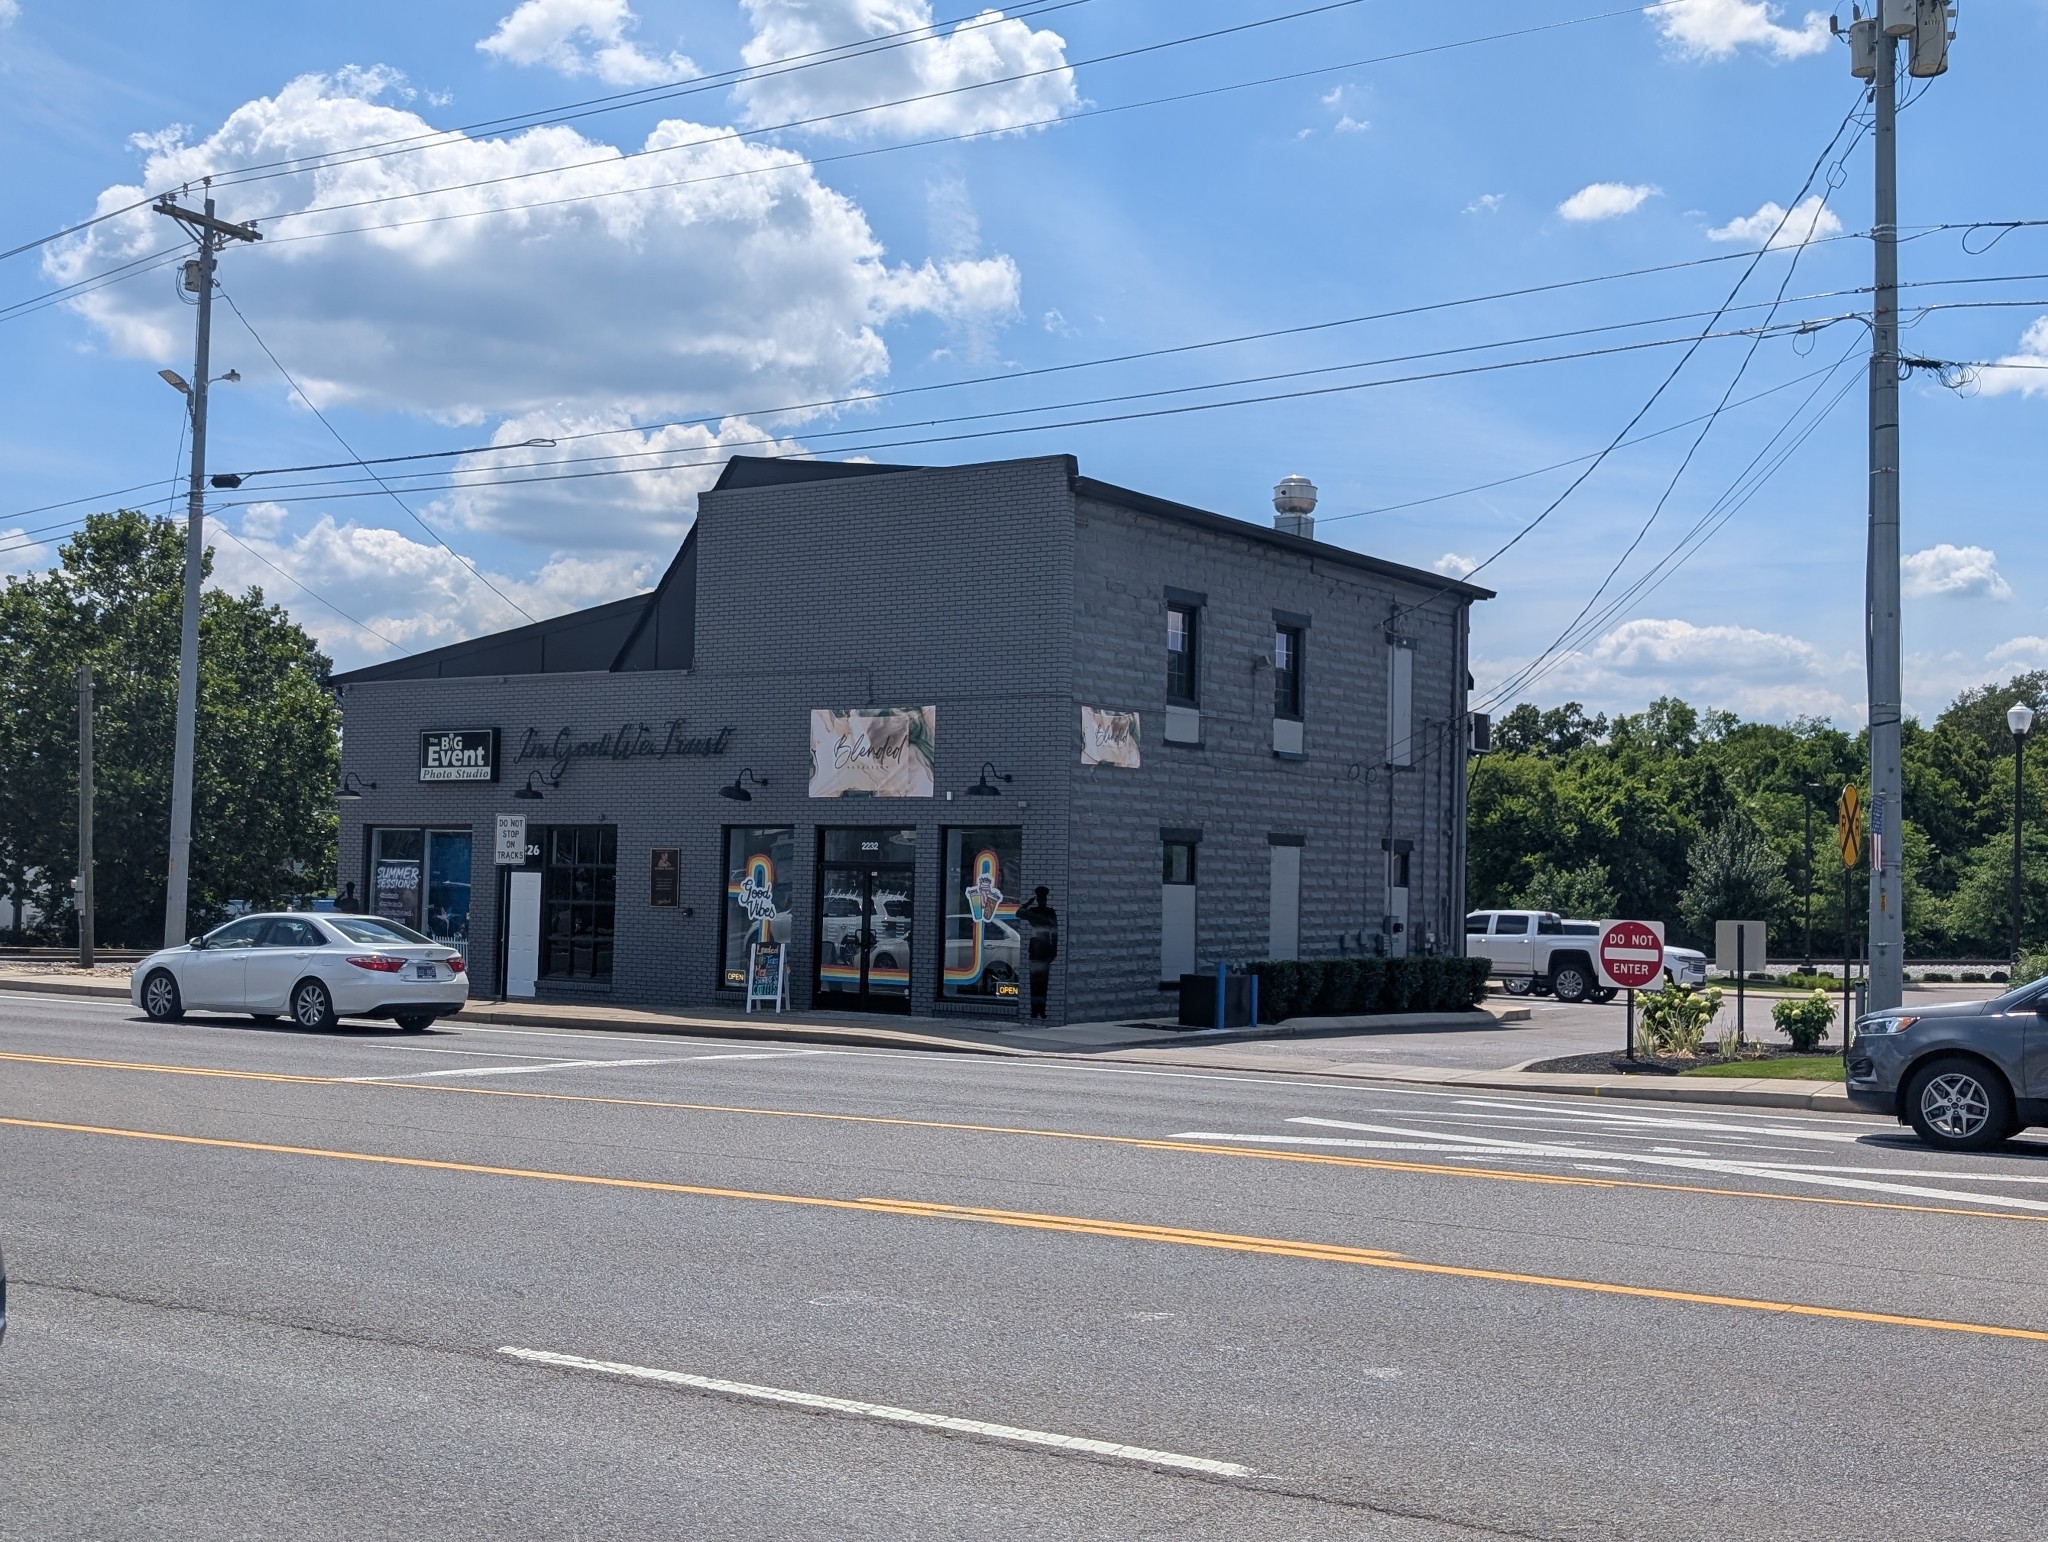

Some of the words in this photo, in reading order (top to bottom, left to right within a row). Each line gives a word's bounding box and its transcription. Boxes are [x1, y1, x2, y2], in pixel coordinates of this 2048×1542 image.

[441, 733, 463, 750] BIG
[1095, 723, 1129, 748] Blended
[550, 726, 611, 780] God
[611, 721, 654, 761] We
[656, 718, 738, 761] Trust
[833, 733, 908, 770] Blended
[427, 746, 485, 767] Event
[423, 769, 452, 779] Photo
[455, 768, 489, 779] Studio
[499, 819, 509, 828] DO
[510, 819, 524, 828] NOT
[502, 830, 520, 838] STOP
[506, 841, 515, 849] ON
[861, 842, 879, 851] 2232
[497, 851, 524, 861] TRACKS
[377, 866, 420, 880] SUMMER
[377, 879, 417, 889] SESSIONS
[740, 878, 772, 904] Good
[746, 899, 776, 919] Vibes
[1609, 933, 1625, 945] DO
[1631, 934, 1654, 946] NOT
[1613, 963, 1649, 976] ENTER
[727, 972, 744, 981] OPEN
[1000, 986, 1019, 995] OPEN
